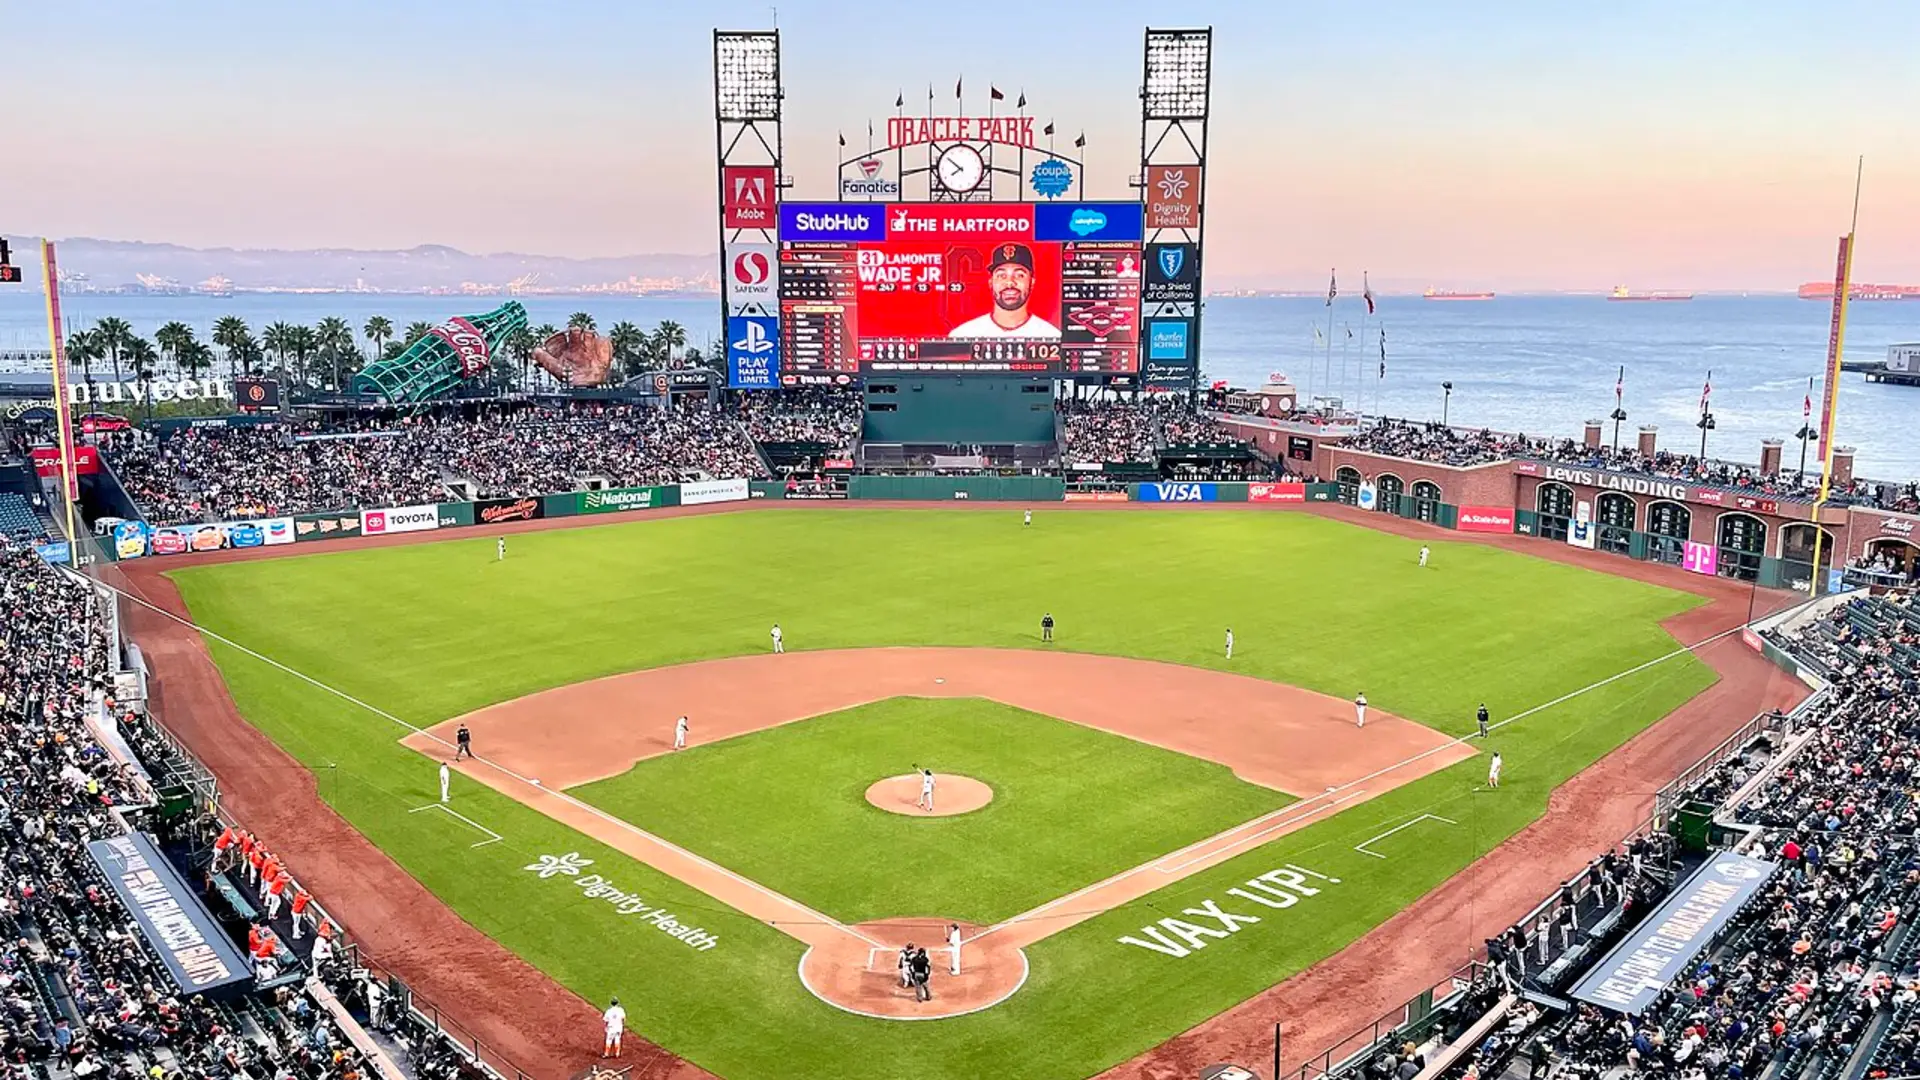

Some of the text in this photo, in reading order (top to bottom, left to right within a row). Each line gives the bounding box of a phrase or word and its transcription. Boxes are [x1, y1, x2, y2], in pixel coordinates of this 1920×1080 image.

[888, 117, 1034, 149] ORACLE PARK
[1036, 167, 1069, 179] coupa
[842, 180, 898, 194] Fanatics
[736, 208, 765, 219] Adobe
[1153, 203, 1191, 215] Dignity
[796, 213, 869, 231] StubHub
[908, 218, 1030, 232] THE HARTFORD
[862, 252, 878, 264] 31
[886, 254, 942, 264] LAMONTE
[860, 267, 911, 282] WADE
[916, 267, 941, 282] JR
[1149, 283, 1192, 291] Blue Shield
[1147, 291, 1194, 299] of California
[1029, 345, 1060, 358] 102
[738, 357, 769, 368] PLAY
[67, 379, 226, 404] nuveen
[709, 487, 733, 495] AMERICA
[1154, 484, 1202, 501] VISA
[1597, 473, 1686, 500] LANDING
[601, 488, 652, 505] National
[390, 513, 435, 525] TOYOTA
[1687, 878, 1742, 908] PARK
[574, 874, 720, 952] Dignity Health
[1116, 863, 1342, 958] VAX UP!
[1653, 899, 1722, 943] ORACLE
[1640, 933, 1687, 957] TO
